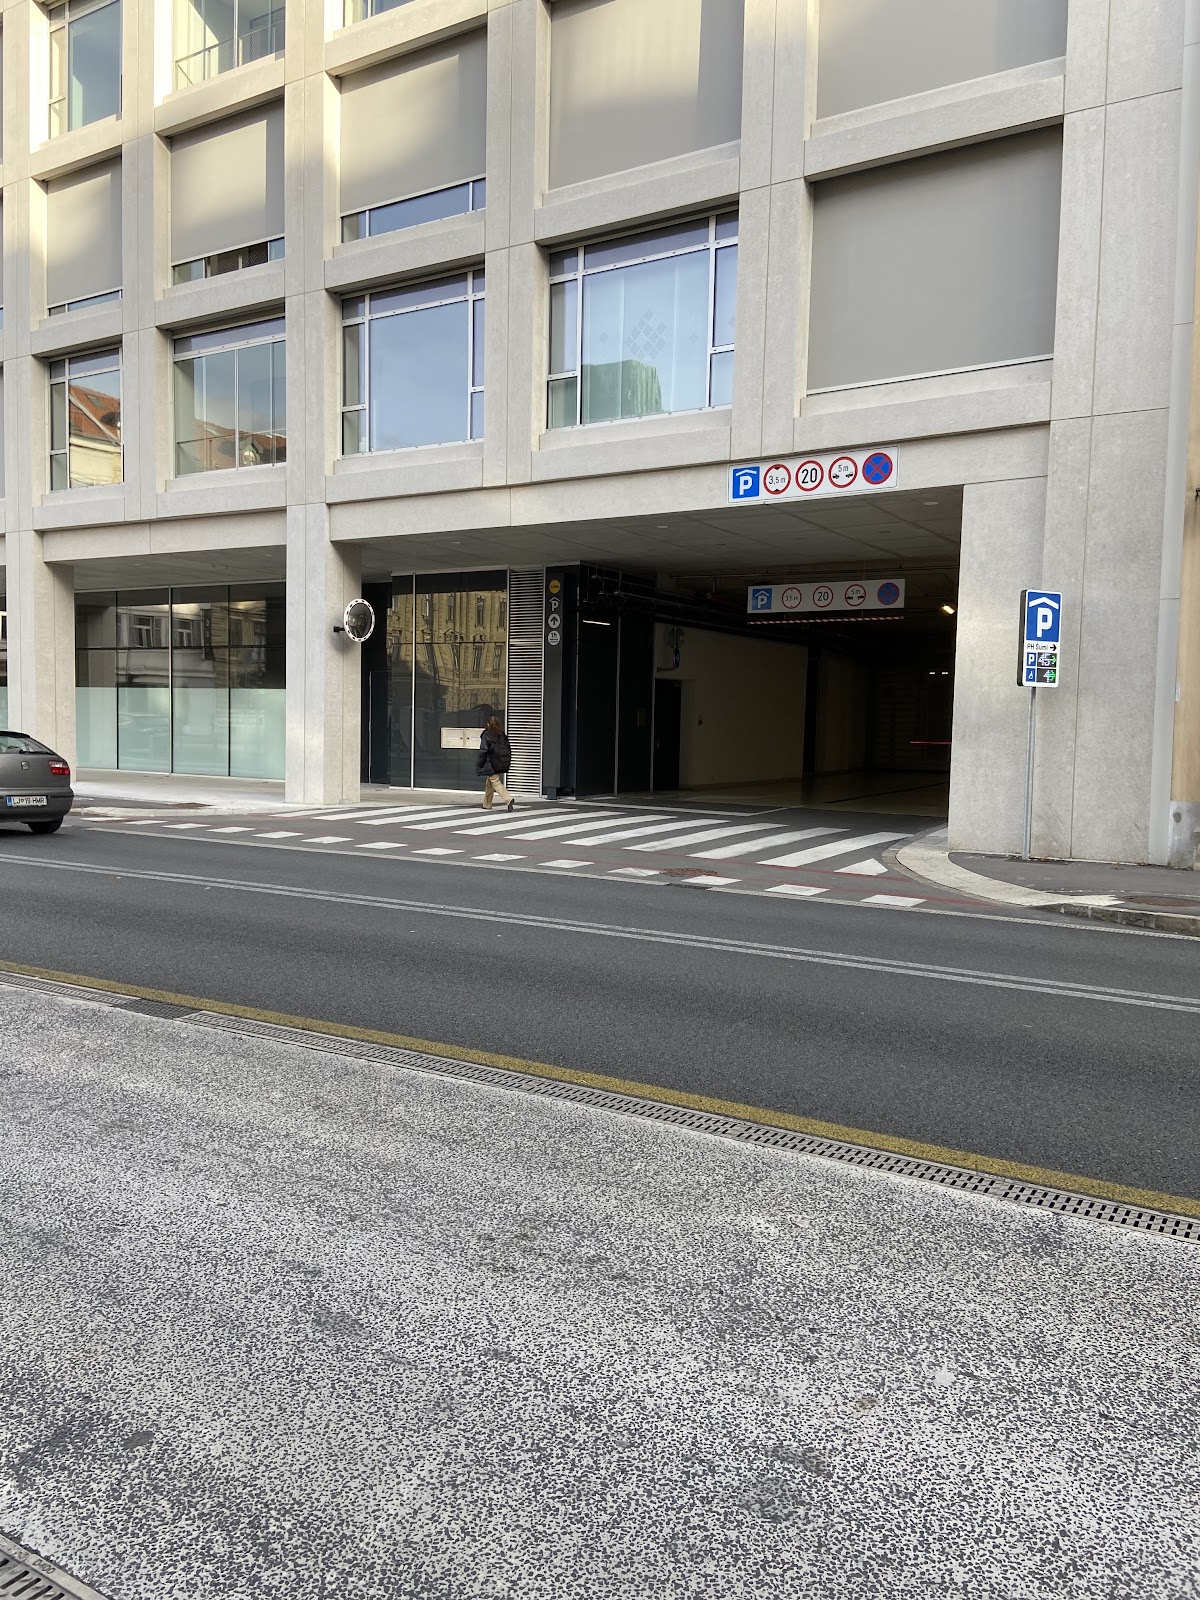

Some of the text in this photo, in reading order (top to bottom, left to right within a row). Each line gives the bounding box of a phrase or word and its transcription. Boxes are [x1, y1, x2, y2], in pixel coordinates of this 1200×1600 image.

[768, 476, 780, 486] 3,5
[801, 467, 818, 484] 20
[739, 475, 753, 496] P
[758, 596, 768, 608] P
[817, 592, 829, 602] 20
[551, 600, 559, 612] P
[1036, 607, 1053, 638] P
[1028, 654, 1035, 665] P
